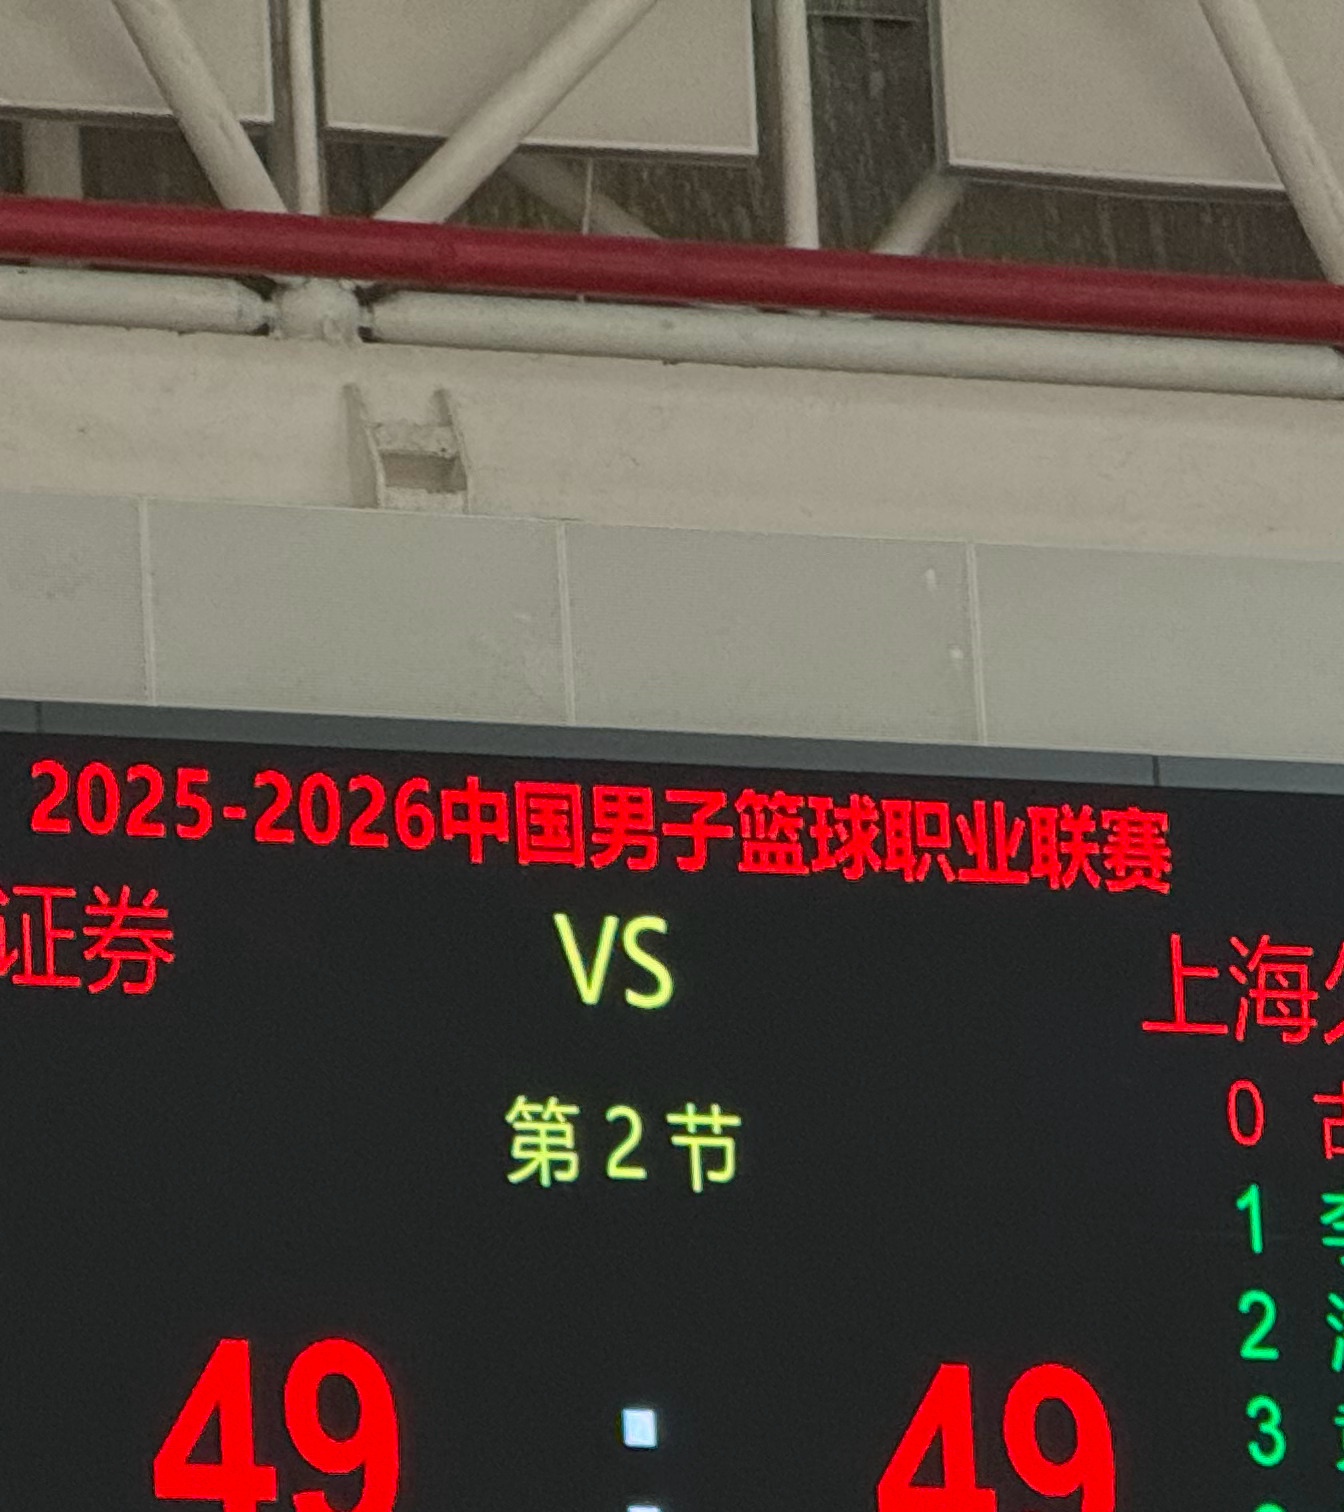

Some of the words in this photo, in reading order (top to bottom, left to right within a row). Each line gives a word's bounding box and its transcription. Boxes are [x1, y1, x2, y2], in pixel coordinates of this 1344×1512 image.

[29, 758, 1174, 896] 2025-2026中国男子篮球职业联赛
[554, 913, 673, 1009] VS
[1228, 1080, 1264, 1146] 0
[1237, 1184, 1262, 1253] 1
[1239, 1290, 1278, 1359] 2
[1247, 1396, 1286, 1466] 3
